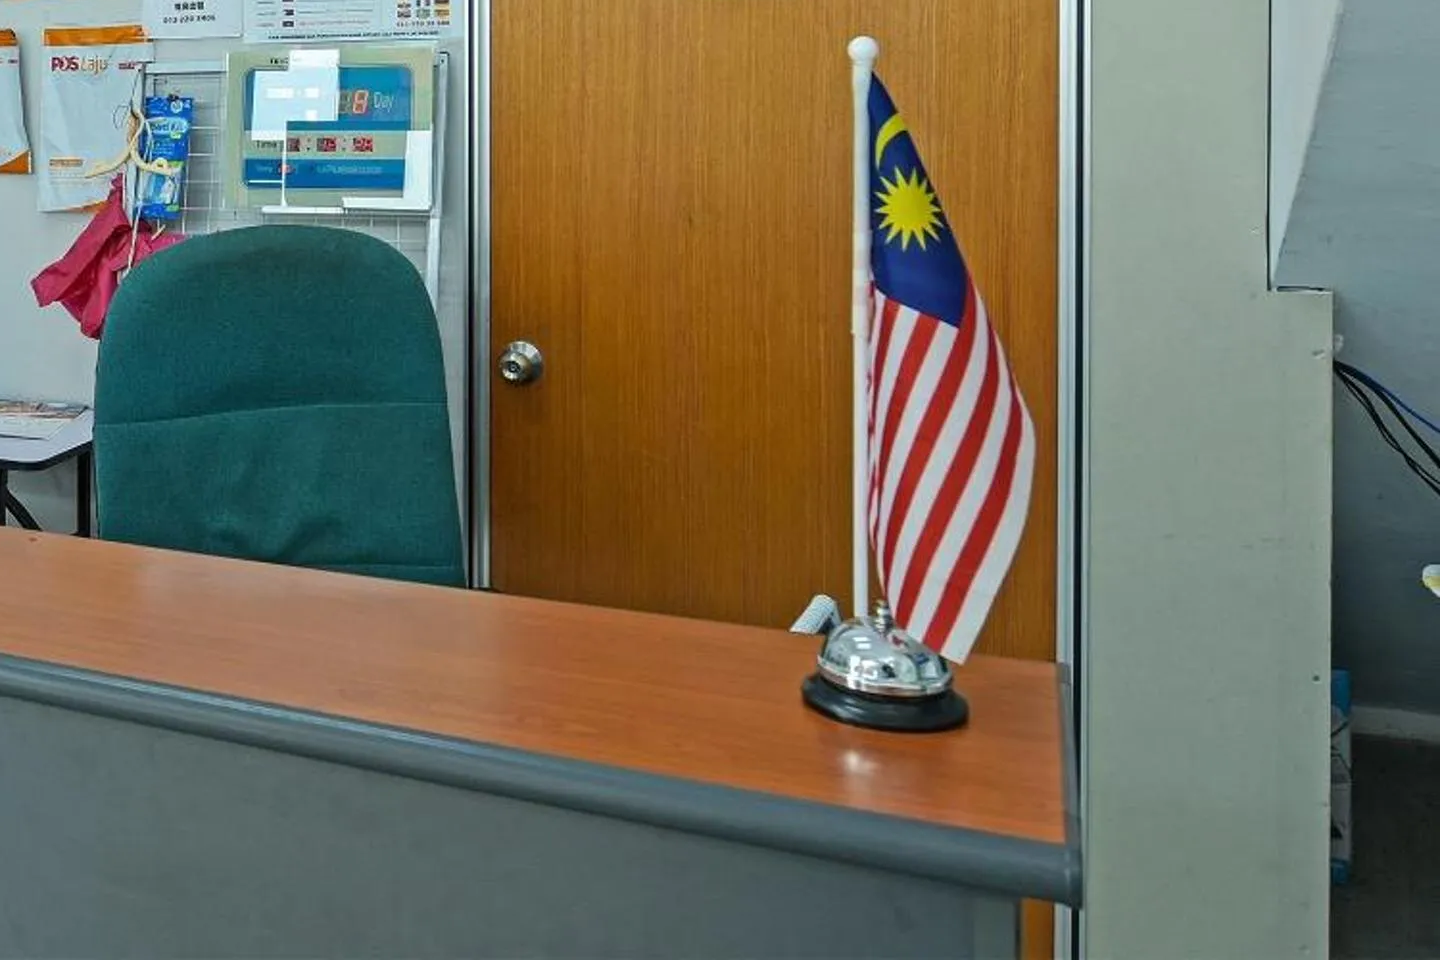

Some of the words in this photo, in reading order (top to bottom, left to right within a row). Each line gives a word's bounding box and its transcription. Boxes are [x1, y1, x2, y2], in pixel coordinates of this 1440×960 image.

[51, 56, 79, 72] POS
[80, 55, 109, 75] Laju
[373, 91, 394, 112] Day
